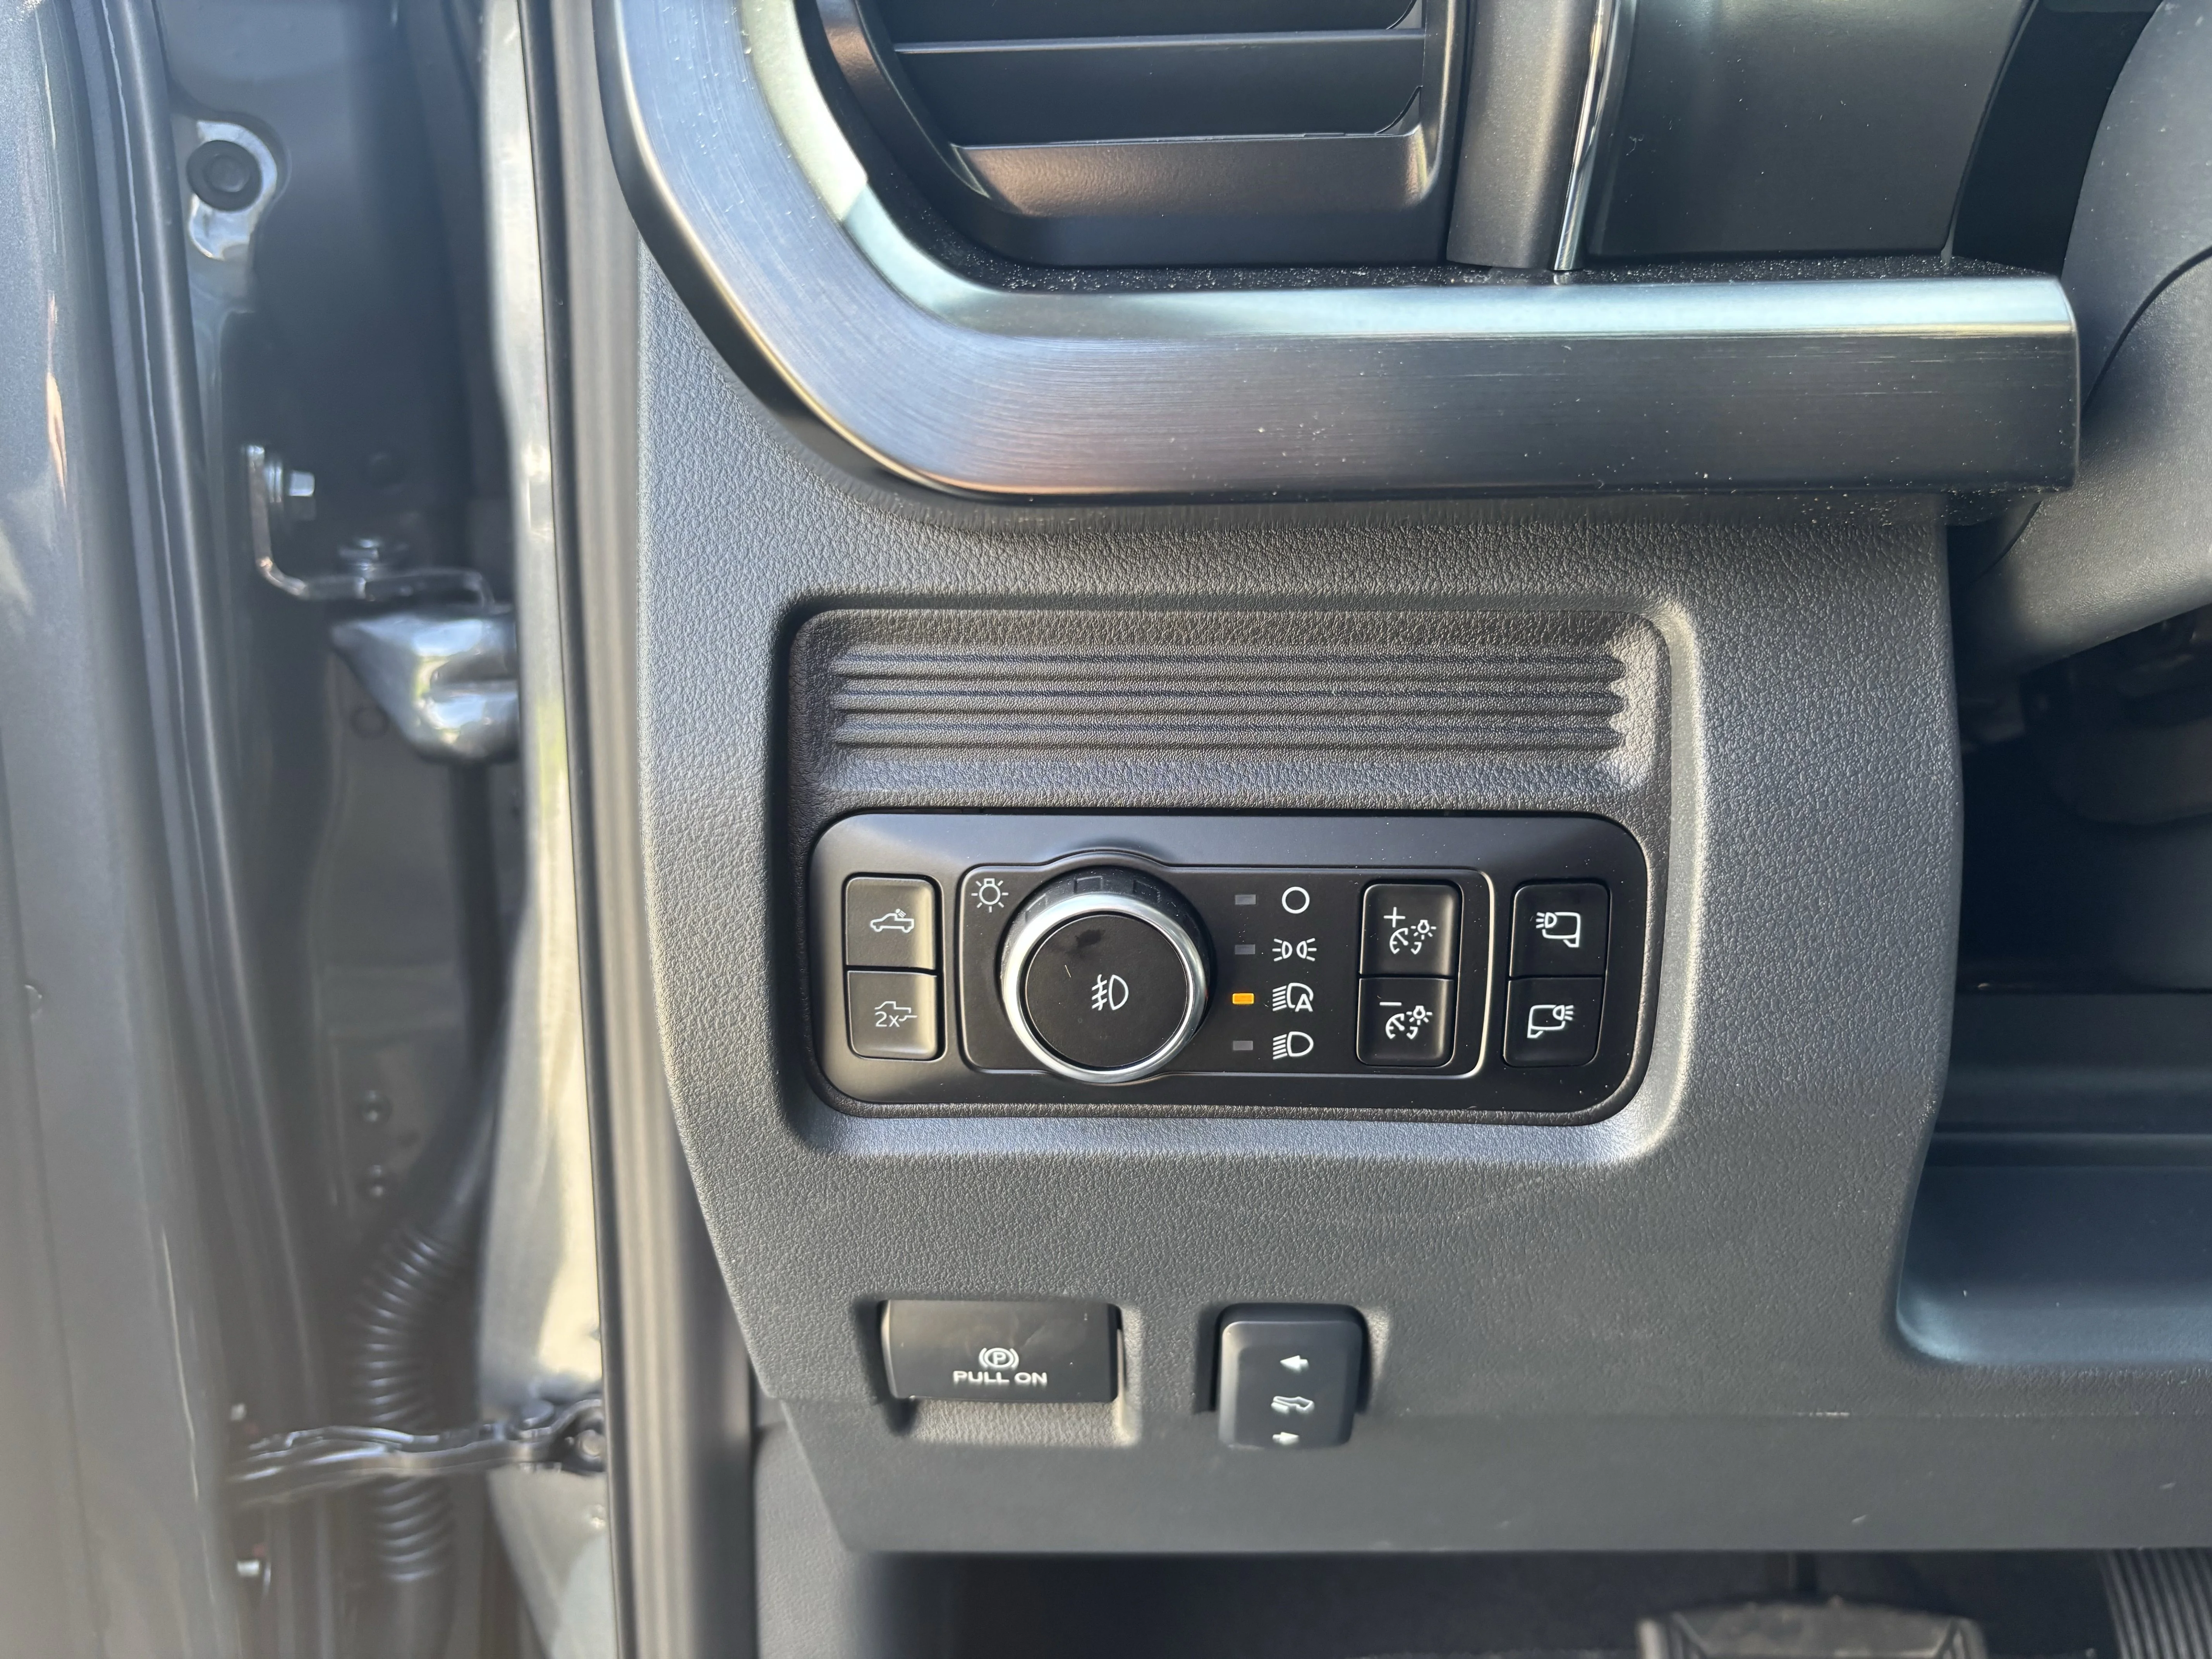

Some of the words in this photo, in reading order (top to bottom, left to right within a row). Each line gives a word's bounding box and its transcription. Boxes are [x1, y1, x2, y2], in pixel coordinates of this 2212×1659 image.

[1295, 993, 1313, 1012] A
[875, 1011, 900, 1027] 2x
[993, 1352, 1006, 1365] P
[953, 1370, 1010, 1384] PULL
[1014, 1372, 1048, 1384] ON
